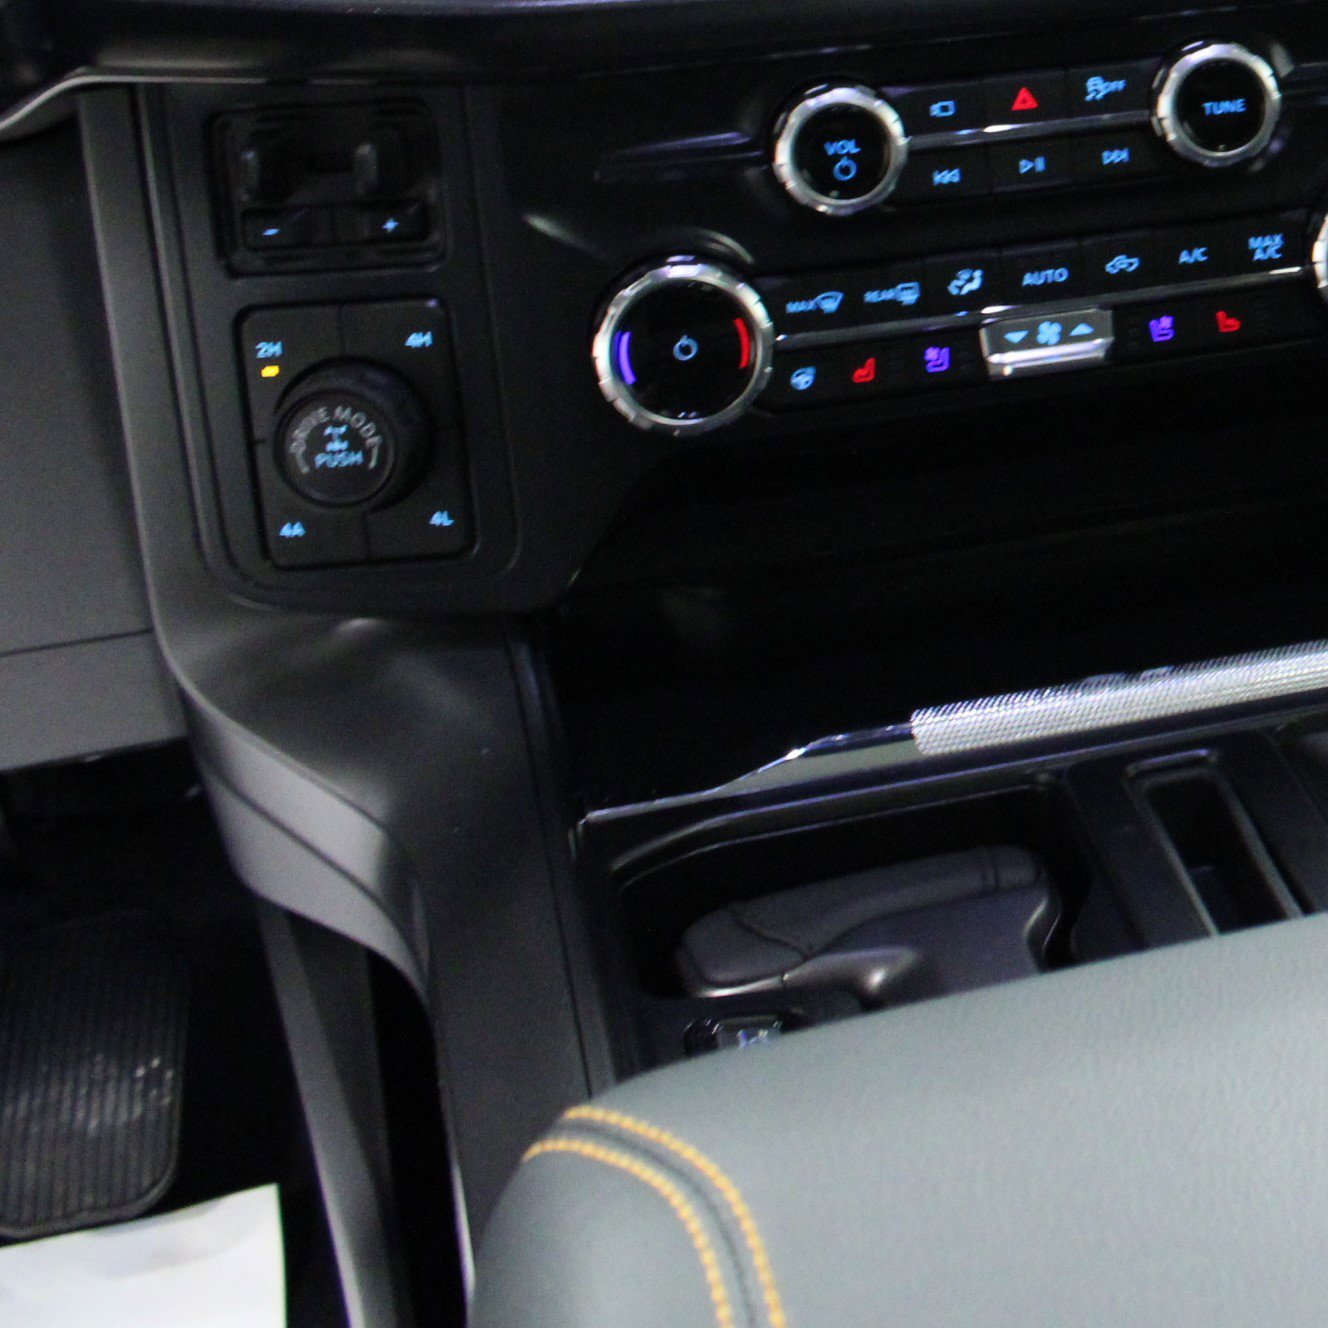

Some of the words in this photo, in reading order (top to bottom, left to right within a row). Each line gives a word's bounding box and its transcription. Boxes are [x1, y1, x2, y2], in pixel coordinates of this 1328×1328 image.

[1202, 98, 1246, 116] TUNE
[824, 139, 861, 156] VOL
[1248, 233, 1284, 249] MAX
[1179, 247, 1209, 264] A/C
[1253, 246, 1283, 262] A/C
[1022, 268, 1070, 287] AUTO
[314, 450, 363, 469] PUSH
